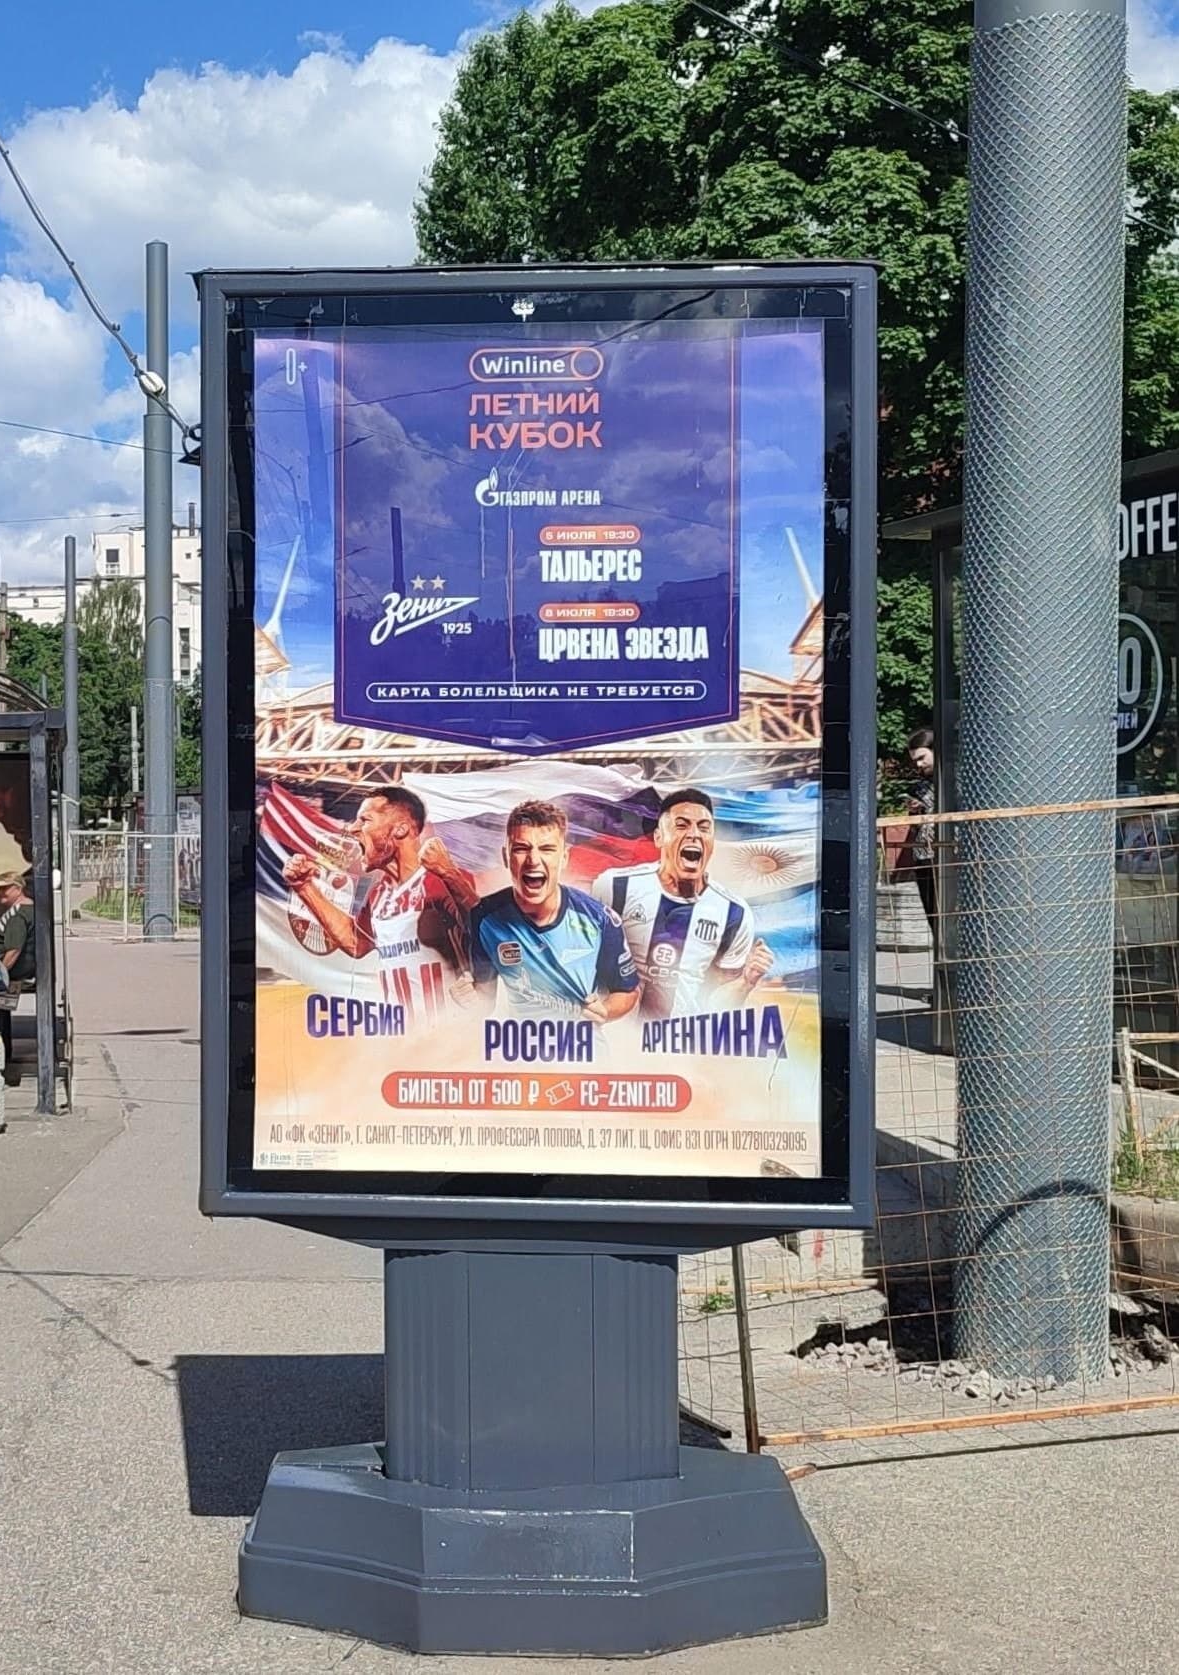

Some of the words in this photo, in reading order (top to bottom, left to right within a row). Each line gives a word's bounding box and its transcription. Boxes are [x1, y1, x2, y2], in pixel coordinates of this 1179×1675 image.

[285, 347, 308, 385] 0+
[481, 356, 566, 374] Winline
[469, 387, 600, 417] ЛЕТНИЙ
[470, 420, 603, 450] КУБОК
[499, 490, 557, 507] ГАЗПРОМ
[561, 489, 601, 506] АРЕНА
[556, 530, 597, 541] ИЮЛЯ
[1117, 491, 1179, 562] OFFE
[539, 549, 642, 582] ТАЛЬЕРЕС
[556, 607, 597, 618] ИЮЛЯ
[441, 622, 473, 635] 1925
[538, 628, 620, 661] ЦРВЕНА
[625, 627, 709, 661] ЗВЕЗДА
[377, 687, 431, 698] КАРТА
[438, 686, 560, 700] БОЛЕЛЬЩИКА
[567, 686, 590, 697] НЕ
[597, 685, 696, 697] ТРЕБУЕТСЯ
[306, 993, 406, 1038] СЕРБИЯ
[484, 1019, 594, 1063] РОССИЯ
[641, 1004, 789, 1060] АРГЕНТИНА
[398, 1078, 463, 1105] БИЛЕТЫ
[468, 1079, 487, 1105] ОТ
[491, 1079, 521, 1105] 500
[579, 1079, 678, 1107] FC-ZENIT.RU
[270, 1124, 283, 1143] АО
[285, 1124, 306, 1143] «ФК
[308, 1124, 354, 1146] «ЗЕНИТ»,
[356, 1125, 363, 1145] Г.
[365, 1124, 457, 1147] САНКТ-ПЕТЕРБУРГ,
[477, 1126, 541, 1147] ПРОФЕССОРА
[600, 1128, 612, 1148] 37
[614, 1128, 637, 1149] ЛИТ.
[654, 1129, 682, 1150] ОФИС
[685, 1130, 701, 1150] 831
[704, 1130, 729, 1150] ОГРН
[731, 1131, 808, 1152] 1027810329095
